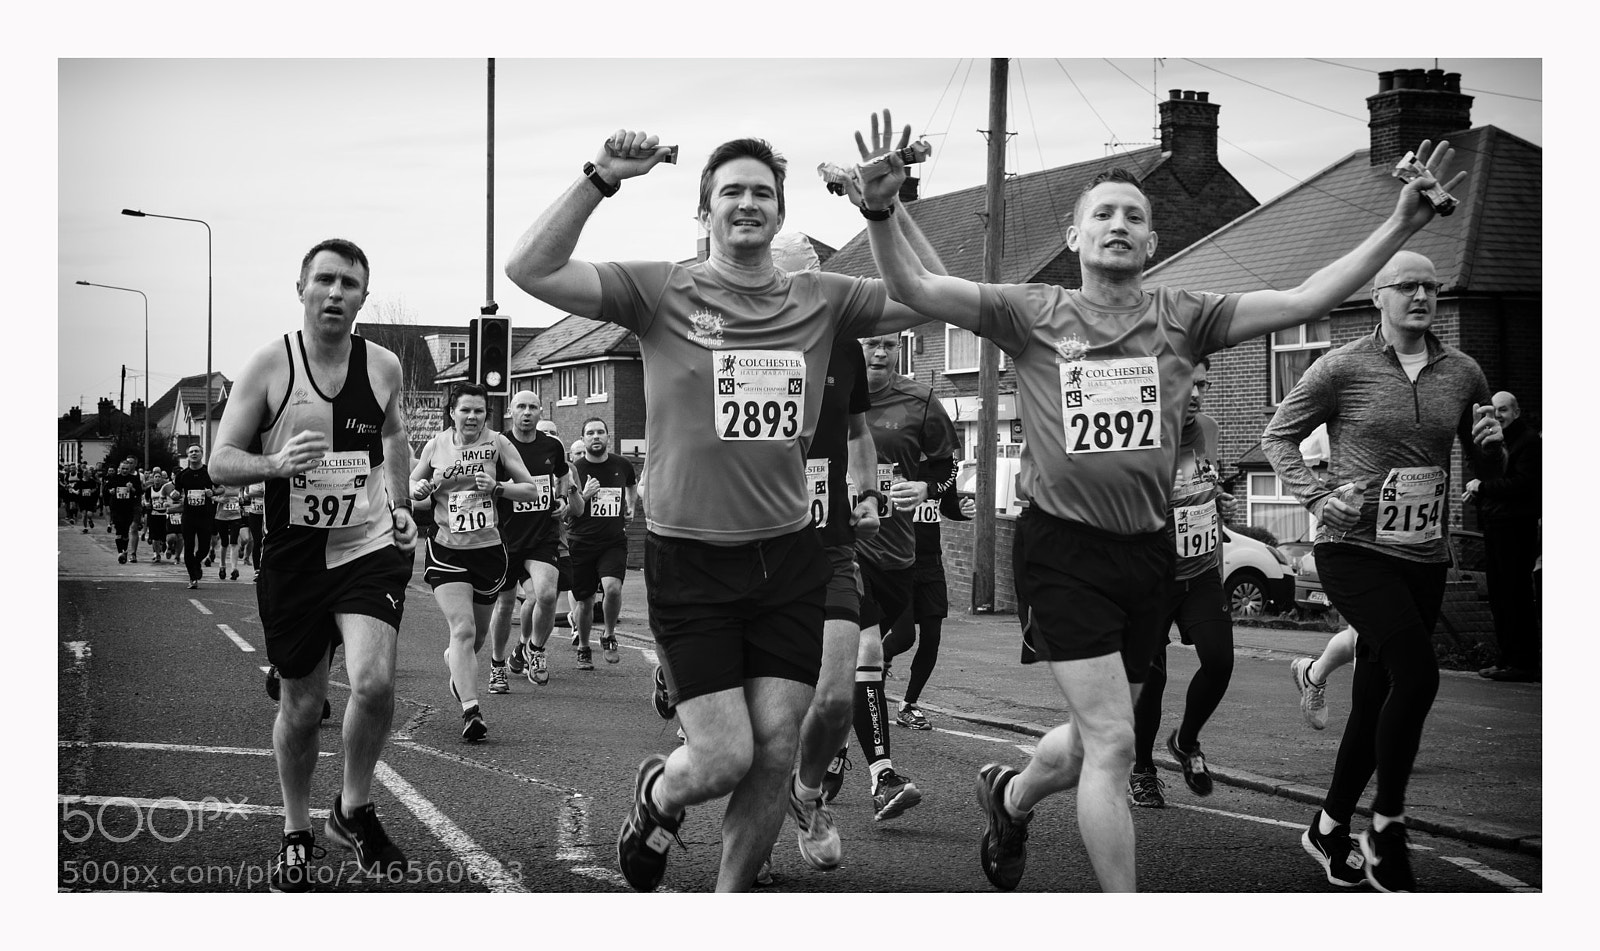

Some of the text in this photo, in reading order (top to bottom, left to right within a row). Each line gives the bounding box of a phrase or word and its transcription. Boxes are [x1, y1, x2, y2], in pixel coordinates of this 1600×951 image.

[738, 358, 802, 368] COLCHESTER
[1085, 366, 1154, 378] COLCHESTER
[1111, 378, 1154, 386] MARATHON
[722, 400, 798, 438] 2893
[1070, 408, 1154, 451] 2892
[462, 449, 497, 461] HAYLEY
[303, 494, 357, 527] 397
[592, 503, 618, 516] 2611
[918, 505, 938, 522] 105
[1382, 500, 1440, 531] 2154
[456, 511, 487, 531] 210
[1183, 528, 1217, 557] 1915
